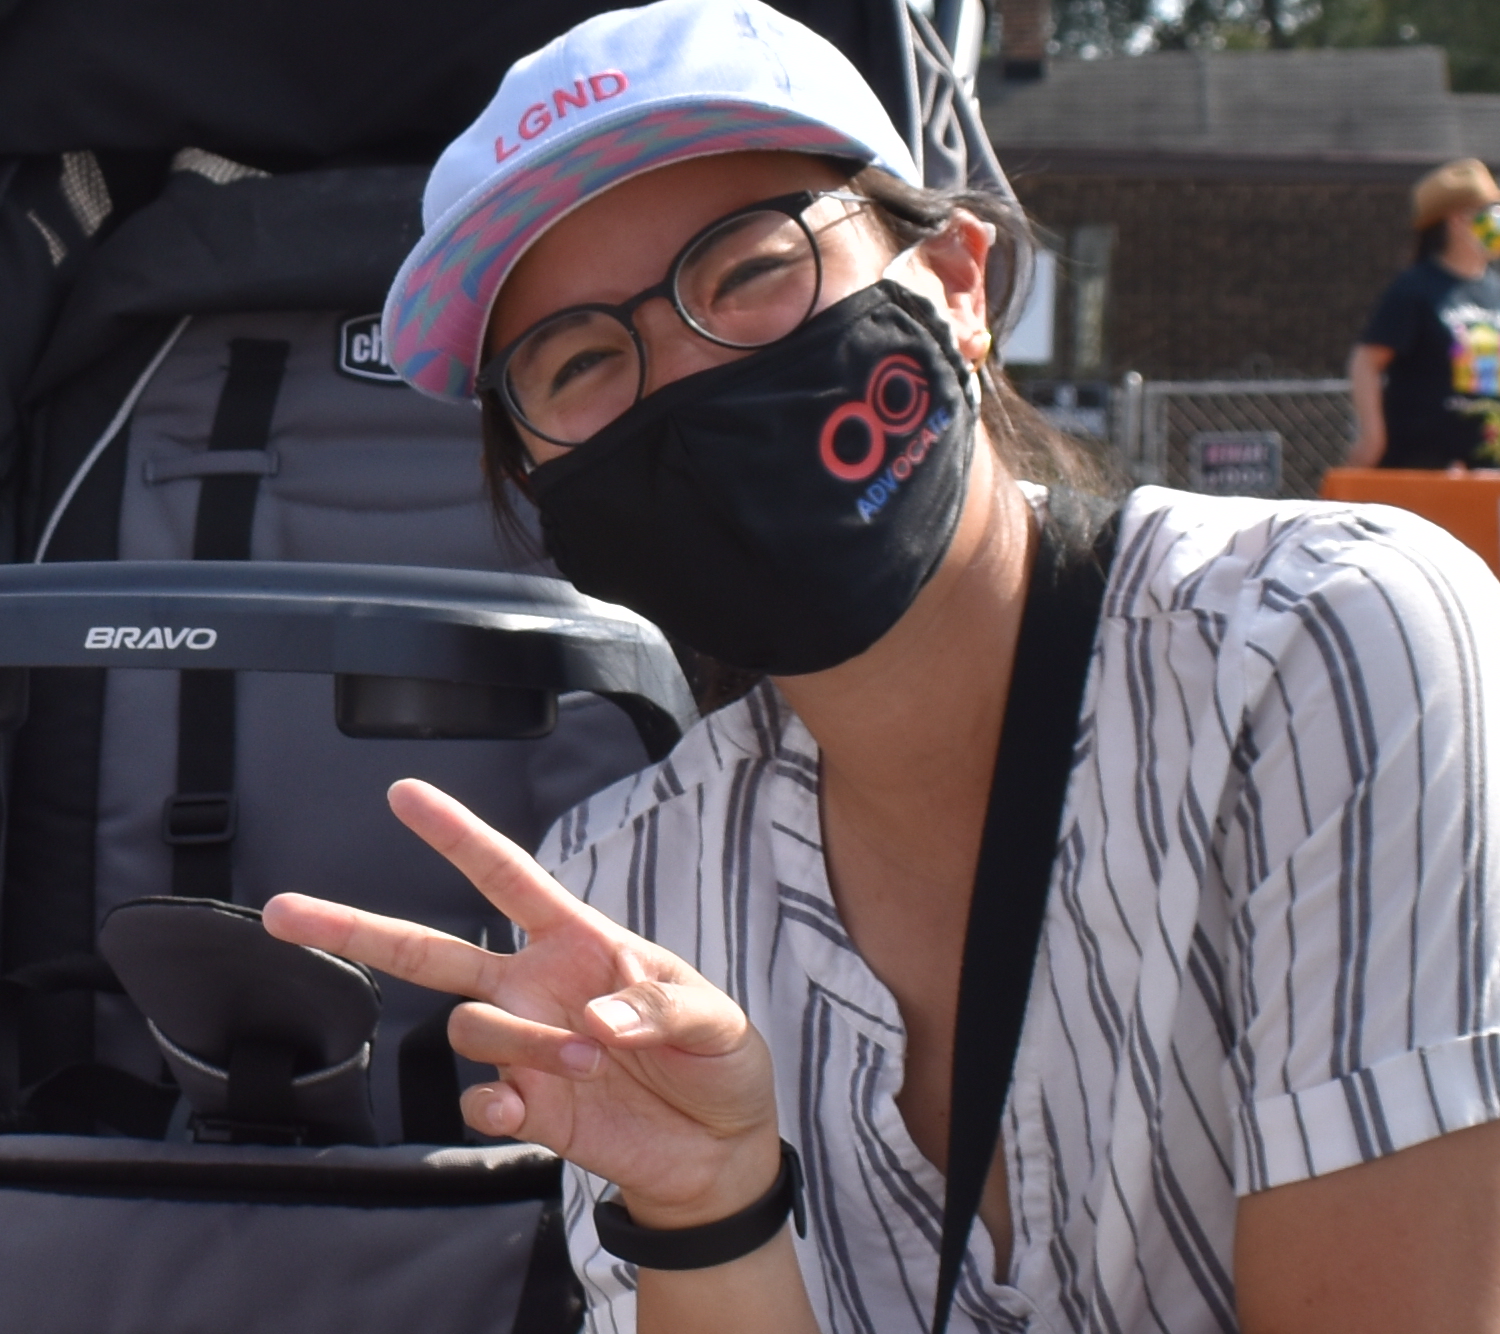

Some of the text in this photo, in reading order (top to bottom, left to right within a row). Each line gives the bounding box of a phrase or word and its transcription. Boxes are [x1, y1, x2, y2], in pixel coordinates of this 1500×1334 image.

[495, 69, 628, 163] LGND
[856, 407, 950, 523] ADVOCATE
[84, 626, 218, 650] BRAVO
